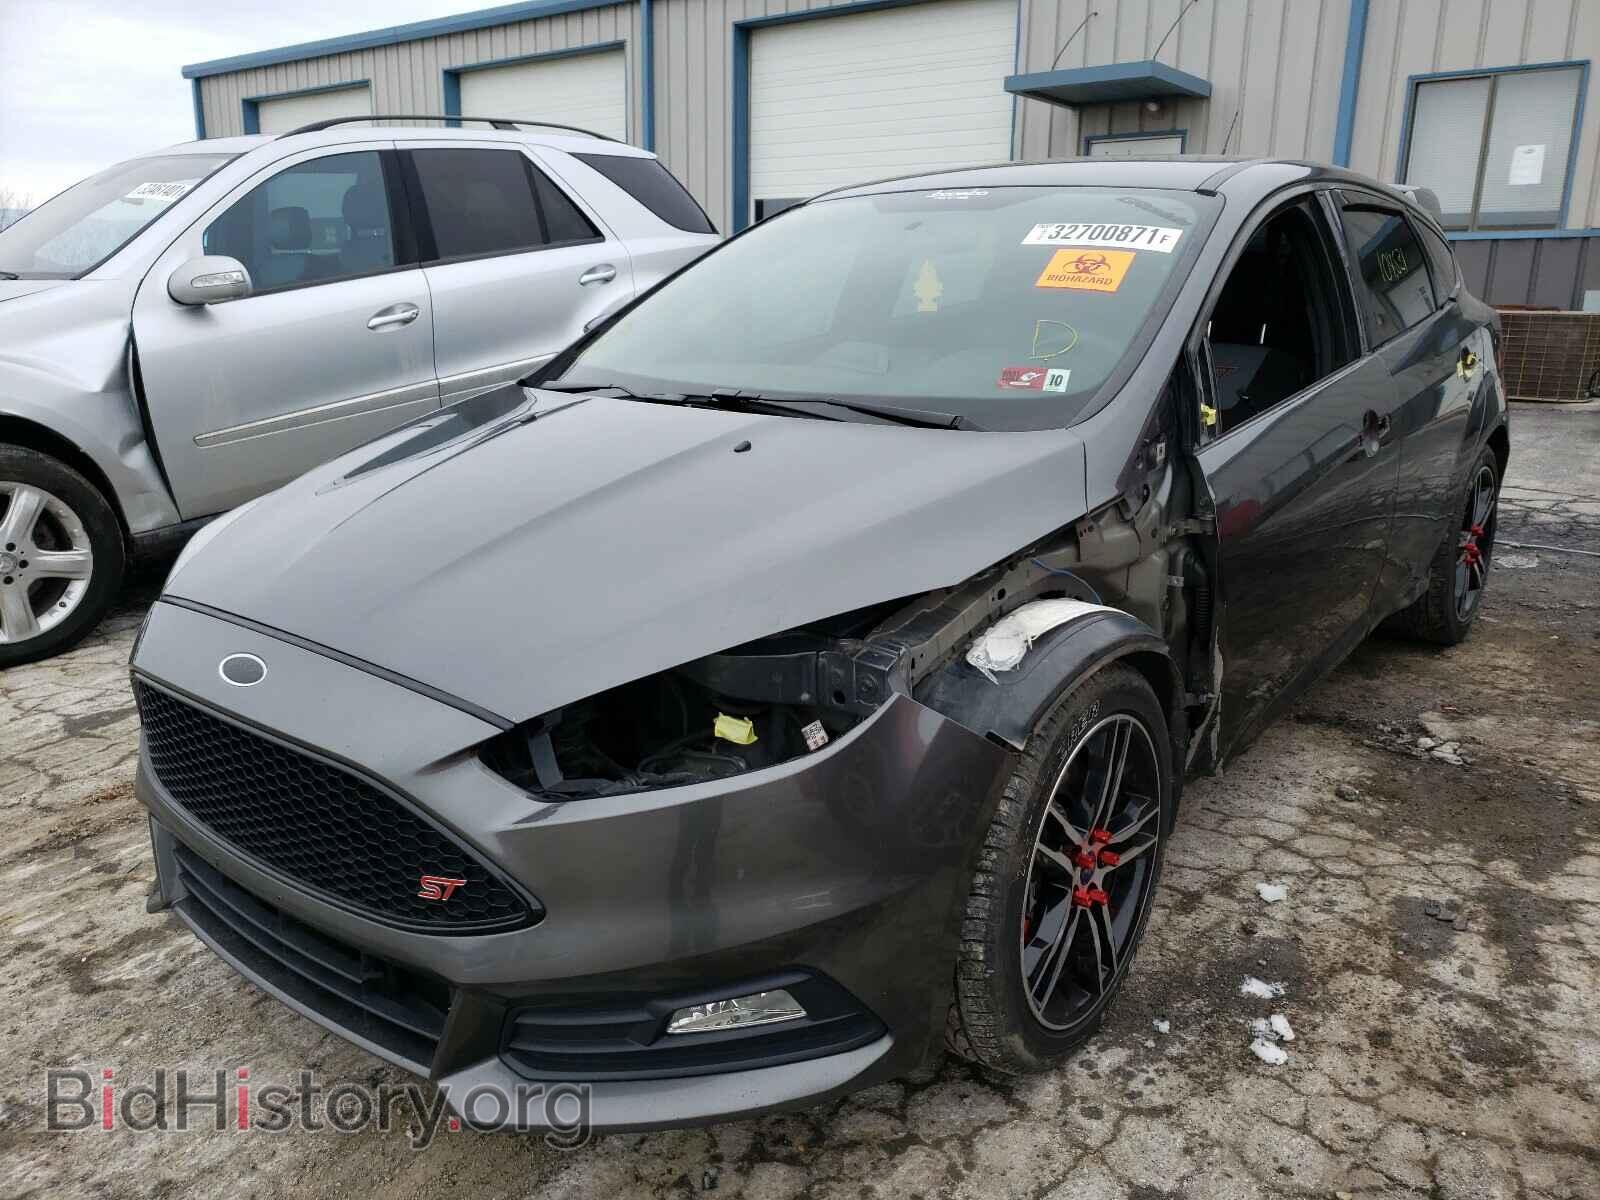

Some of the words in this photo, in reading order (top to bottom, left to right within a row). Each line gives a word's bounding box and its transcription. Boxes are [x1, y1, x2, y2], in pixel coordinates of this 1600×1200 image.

[1048, 224, 1160, 244] 32700871
[1046, 273, 1113, 286] BIOHAZARD
[1030, 319, 1079, 360] D
[1048, 374, 1064, 386] 10
[417, 875, 467, 901] ST
